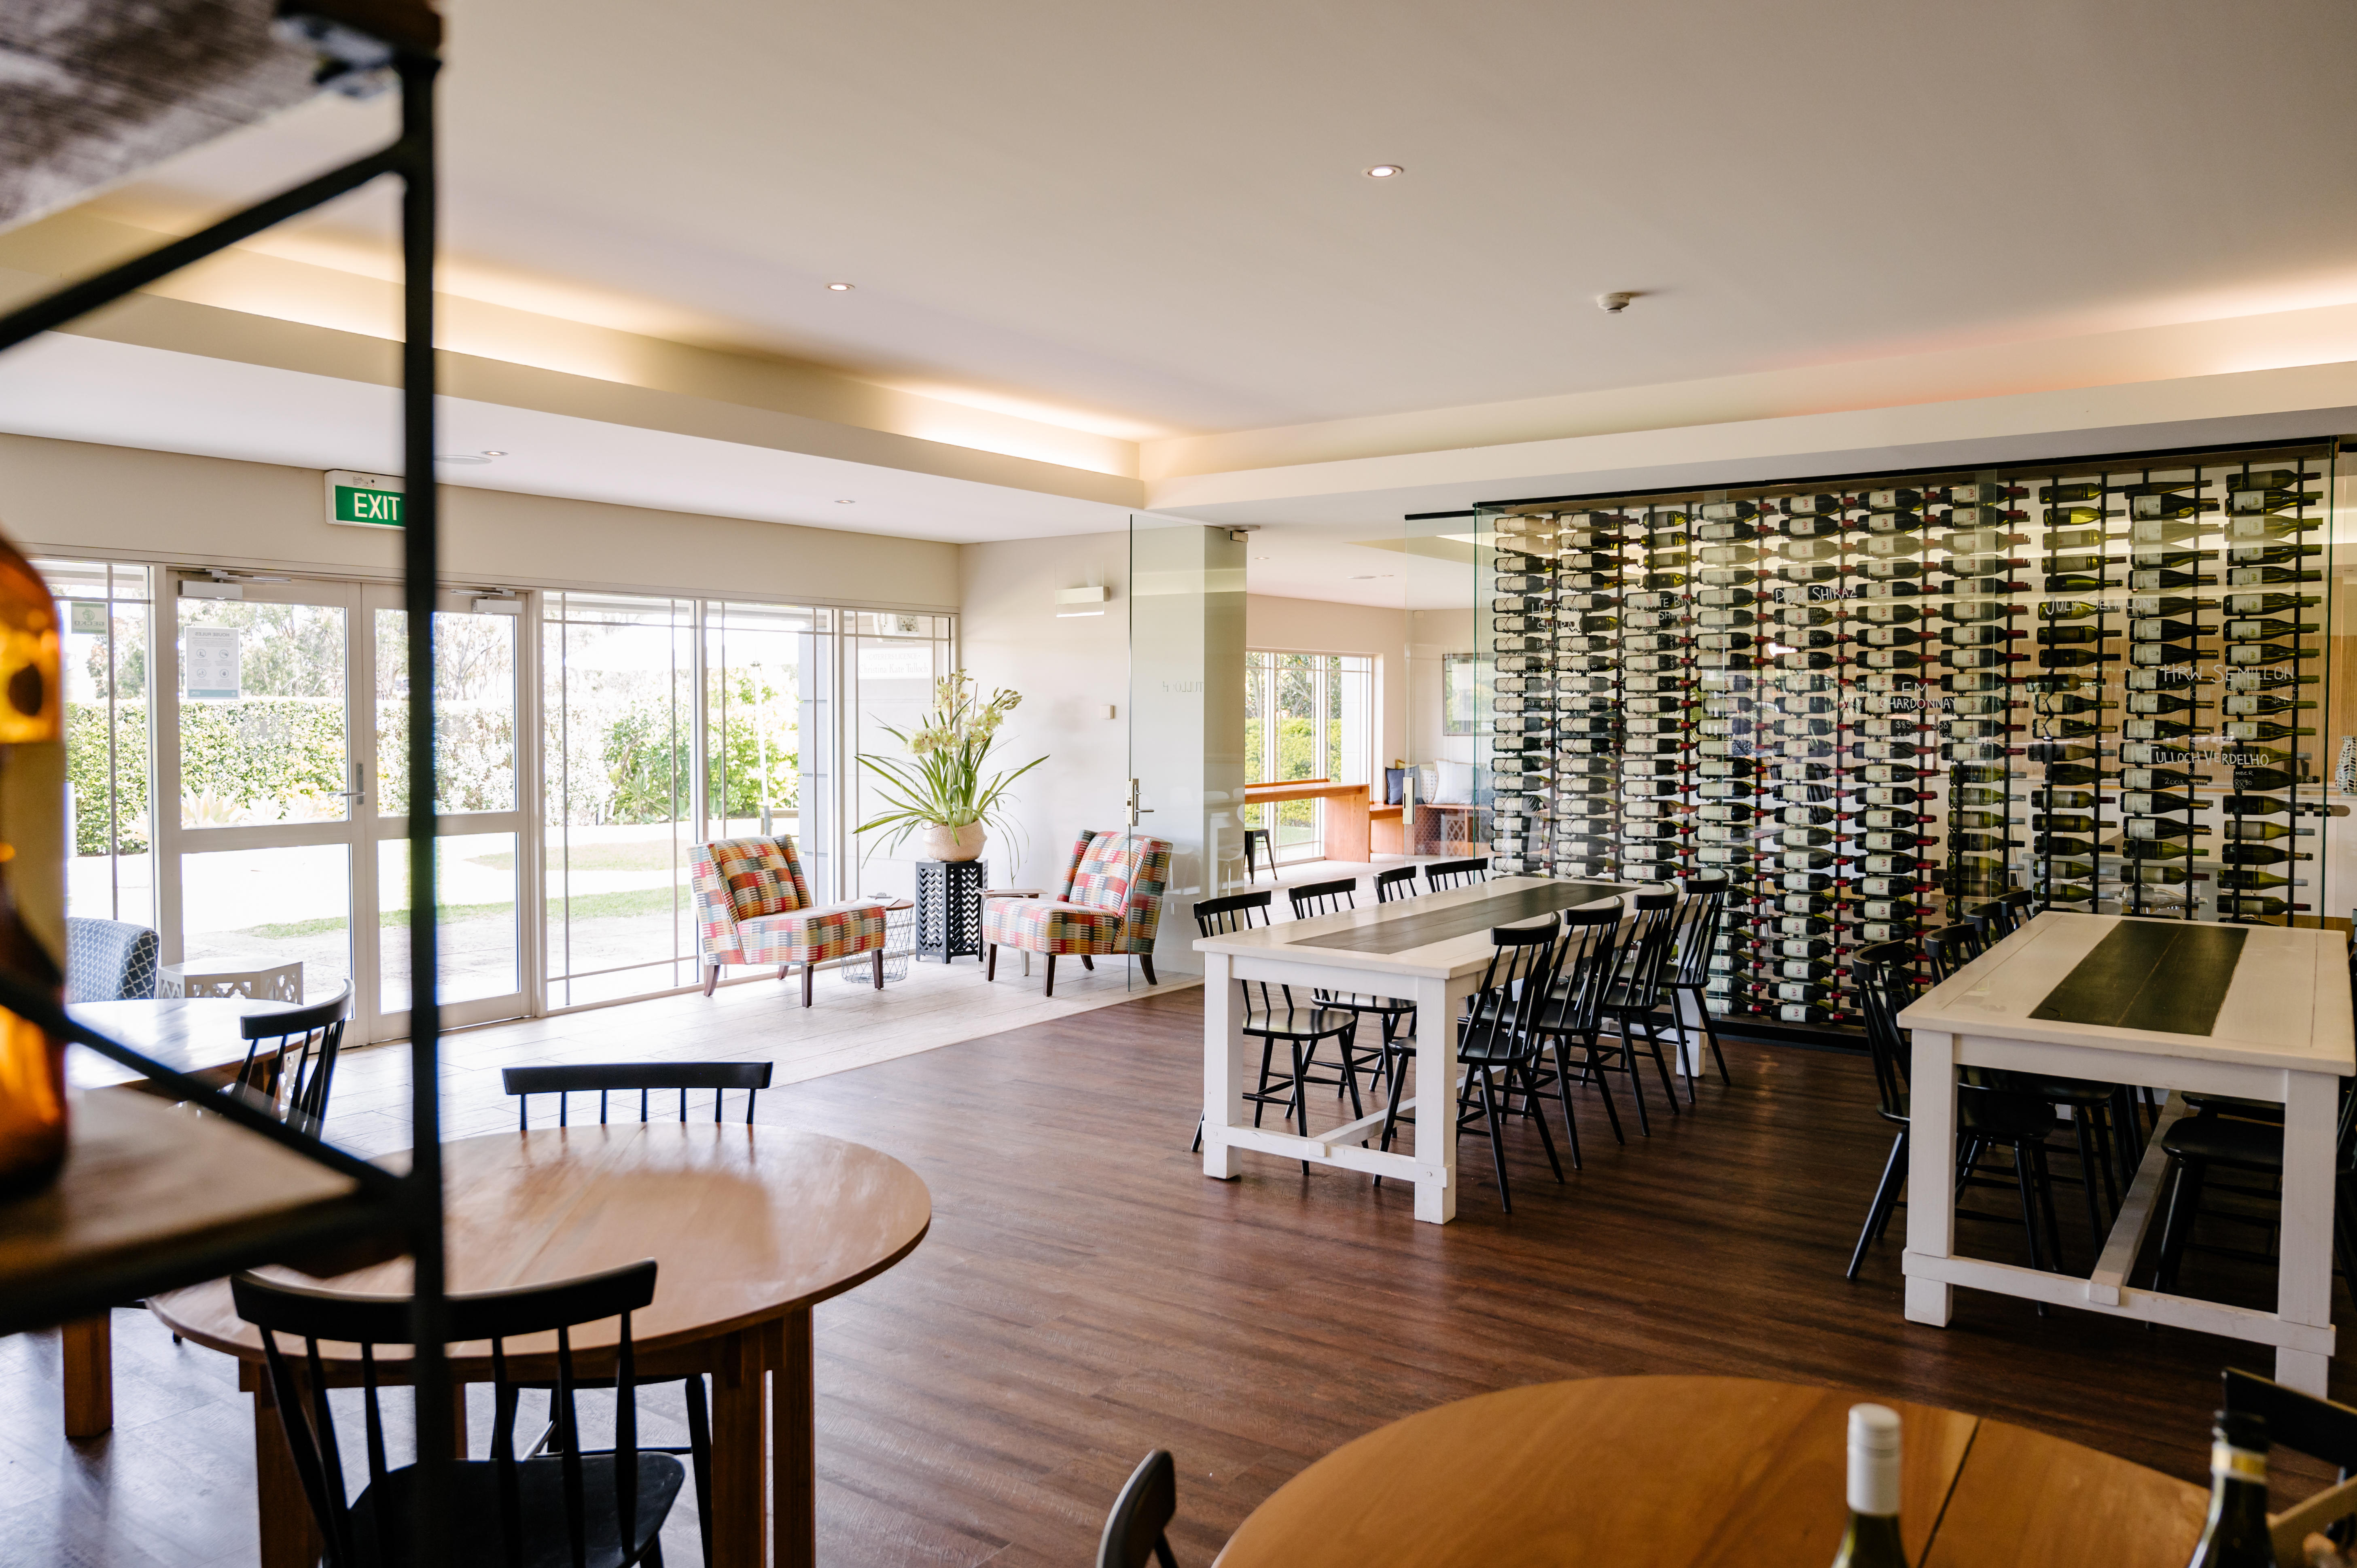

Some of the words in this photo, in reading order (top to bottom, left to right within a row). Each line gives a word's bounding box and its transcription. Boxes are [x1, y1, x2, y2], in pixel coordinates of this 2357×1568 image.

[354, 492, 401, 521] EXIT
[1674, 595, 1691, 607] BIN
[1812, 587, 1857, 604] SHIRAZ
[1532, 602, 1579, 621] HECTOR
[2043, 595, 2083, 615] JULIA
[2088, 595, 2151, 611] SEMILLON
[1658, 609, 1690, 620] SHIRAZ
[1537, 619, 1582, 635] SHIRAZ
[858, 663, 887, 674] Christina
[890, 663, 904, 673] Kate
[906, 662, 928, 673] Tulloch
[2164, 663, 2202, 683] HRW
[2211, 664, 2294, 683] SEMILLON
[1880, 697, 1957, 710] CHARDONNAY
[2149, 746, 2200, 764] TULLOCH
[2204, 749, 2269, 767] VERDELHO
